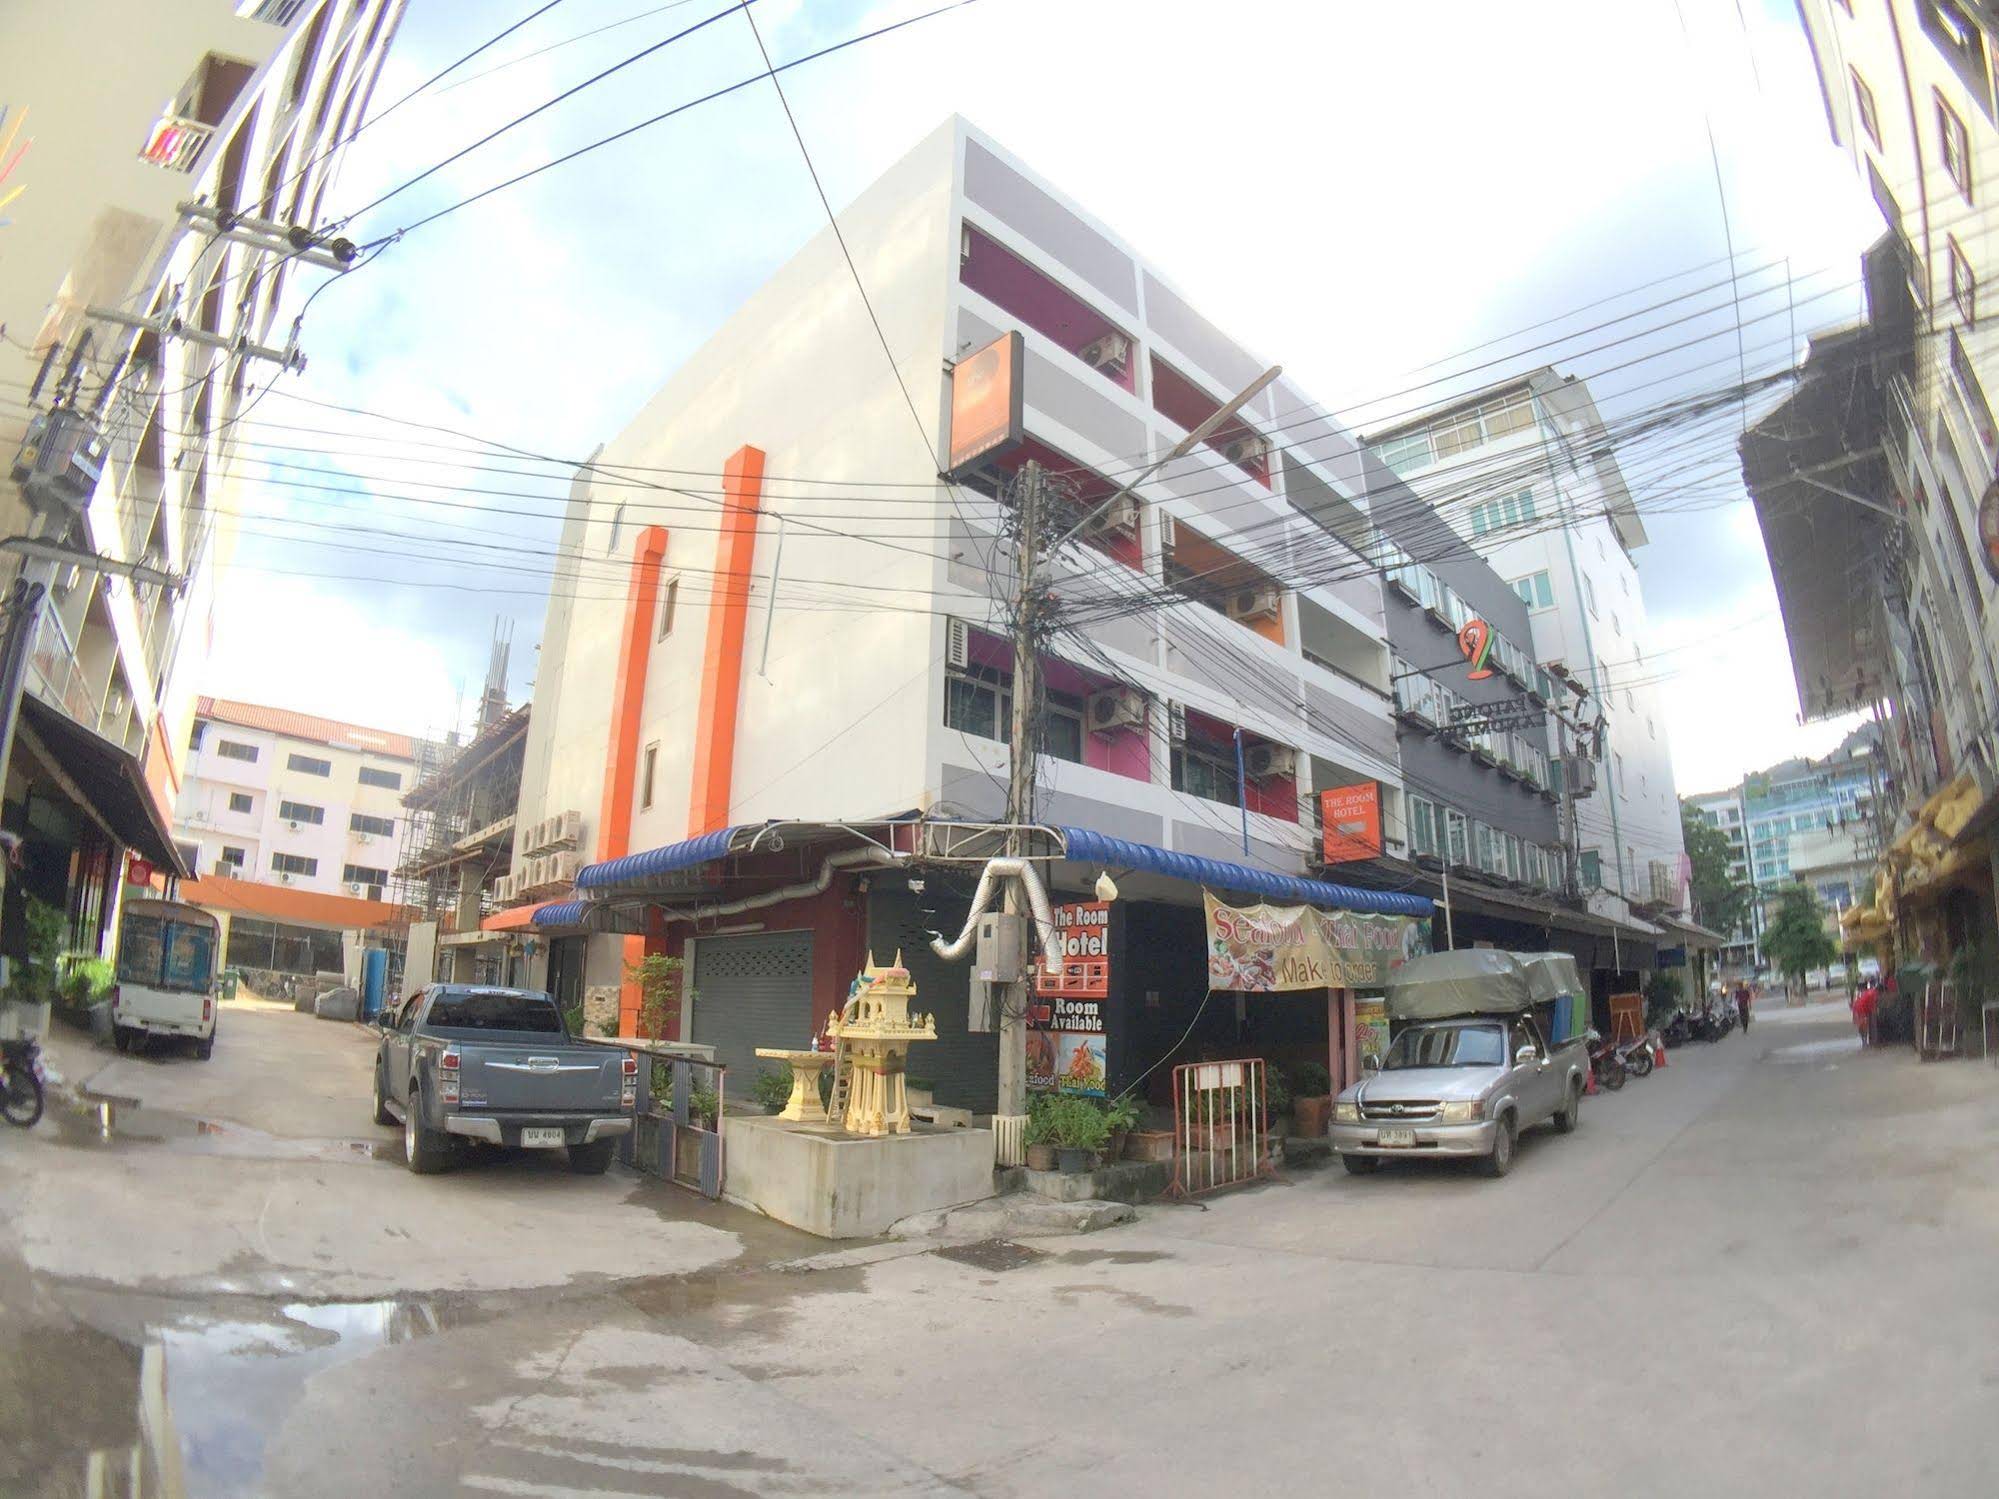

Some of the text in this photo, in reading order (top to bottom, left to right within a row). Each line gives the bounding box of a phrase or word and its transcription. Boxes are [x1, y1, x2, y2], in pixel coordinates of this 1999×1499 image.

[1324, 791, 1375, 808] THE ROOM
[1334, 806, 1367, 818] HOTEL
[1054, 905, 1109, 927] The Room
[1212, 907, 1399, 950] Seafood Thai Food
[1056, 927, 1109, 956] Hotel
[1055, 997, 1099, 1015] Room
[1050, 1014, 1103, 1031] Available
